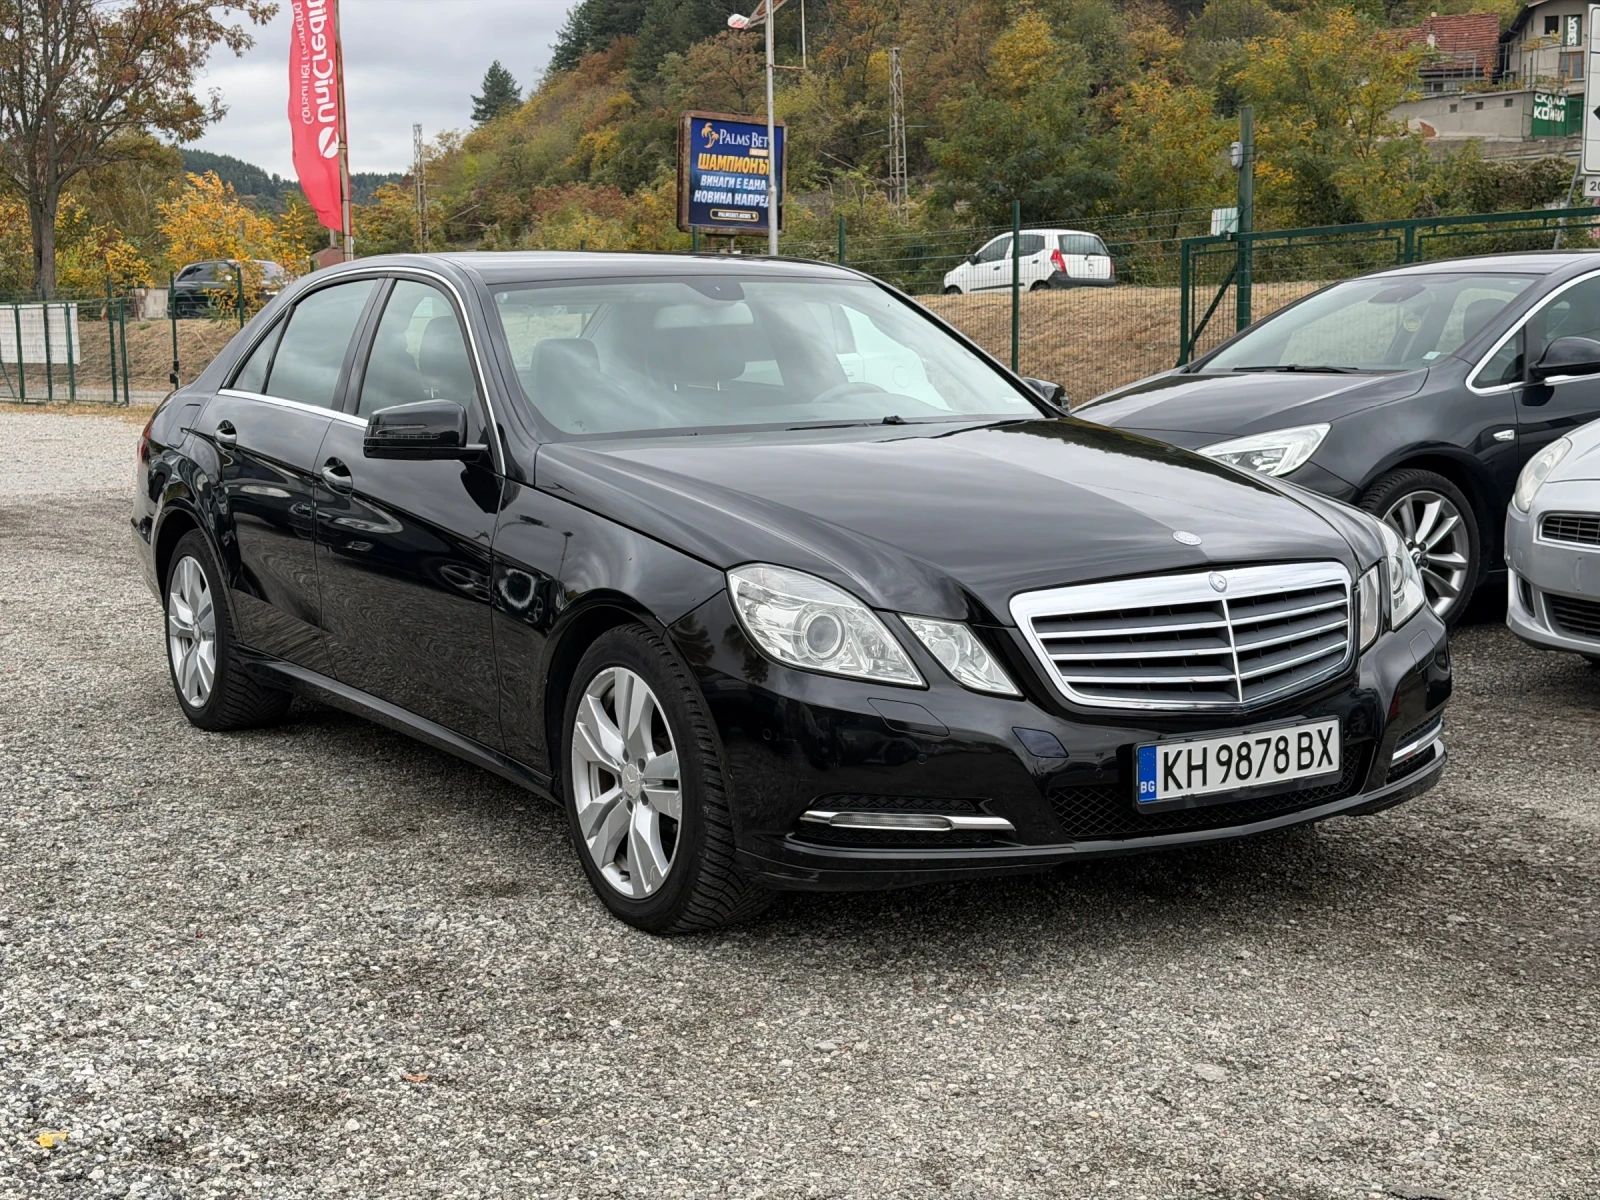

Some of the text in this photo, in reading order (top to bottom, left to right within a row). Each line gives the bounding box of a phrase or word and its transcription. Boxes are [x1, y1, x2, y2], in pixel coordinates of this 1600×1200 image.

[719, 129, 768, 148] PALMS BET
[700, 175, 766, 191] ВИНАГИ Е ЕДНА
[694, 190, 732, 205] НОВИНА
[1163, 727, 1334, 792] KH 9878 BX
[1140, 781, 1155, 793] BG
